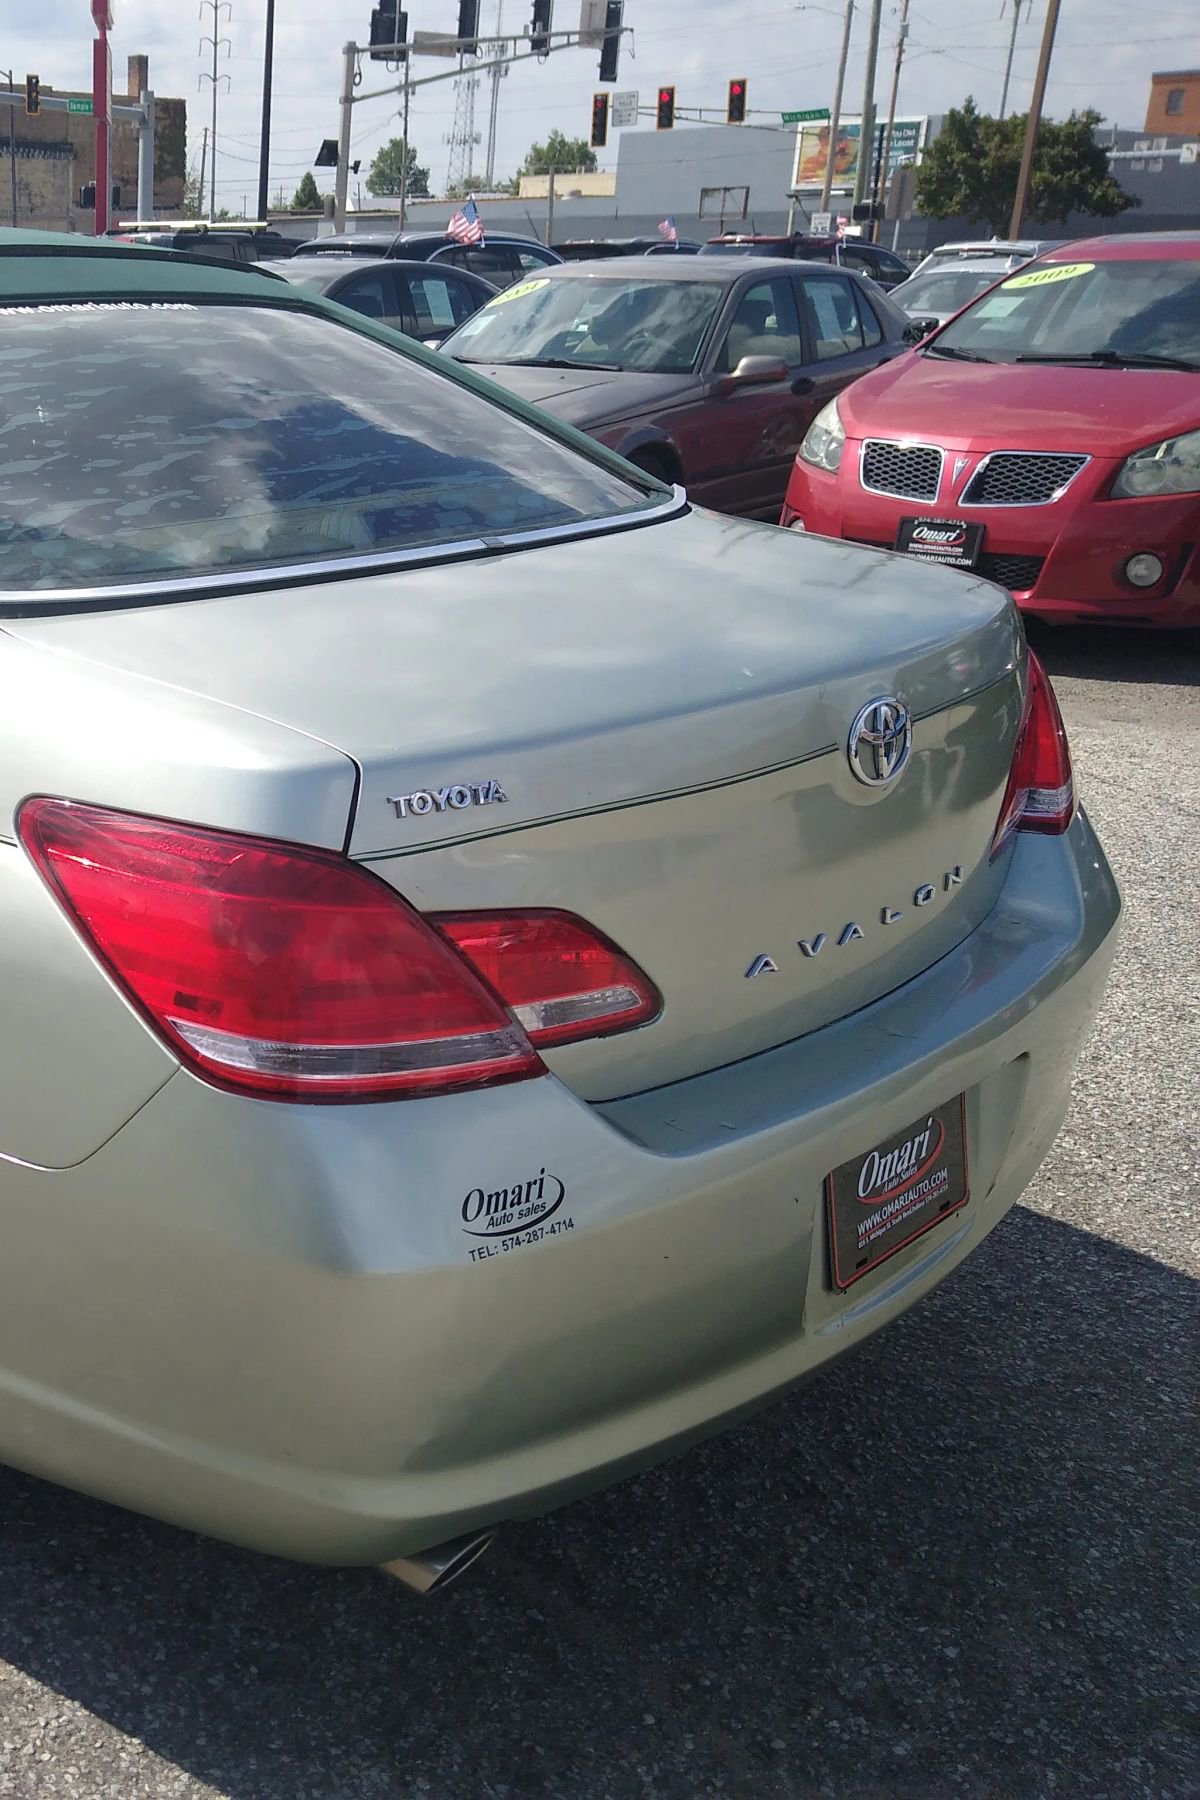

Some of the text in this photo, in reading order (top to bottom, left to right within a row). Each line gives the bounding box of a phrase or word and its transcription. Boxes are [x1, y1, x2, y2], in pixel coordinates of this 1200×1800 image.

[783, 111, 820, 121] Michigan
[912, 526, 961, 542] Omari
[387, 780, 508, 818] TOYOTA
[745, 865, 964, 978] AVALON
[858, 1116, 934, 1198] Omari
[461, 1167, 546, 1222] Omari
[486, 1201, 547, 1230] Auto sales
[857, 1168, 948, 1236] WWW.OMARIAUTO.COM
[468, 1217, 575, 1262] TEL: 574-287-4714
